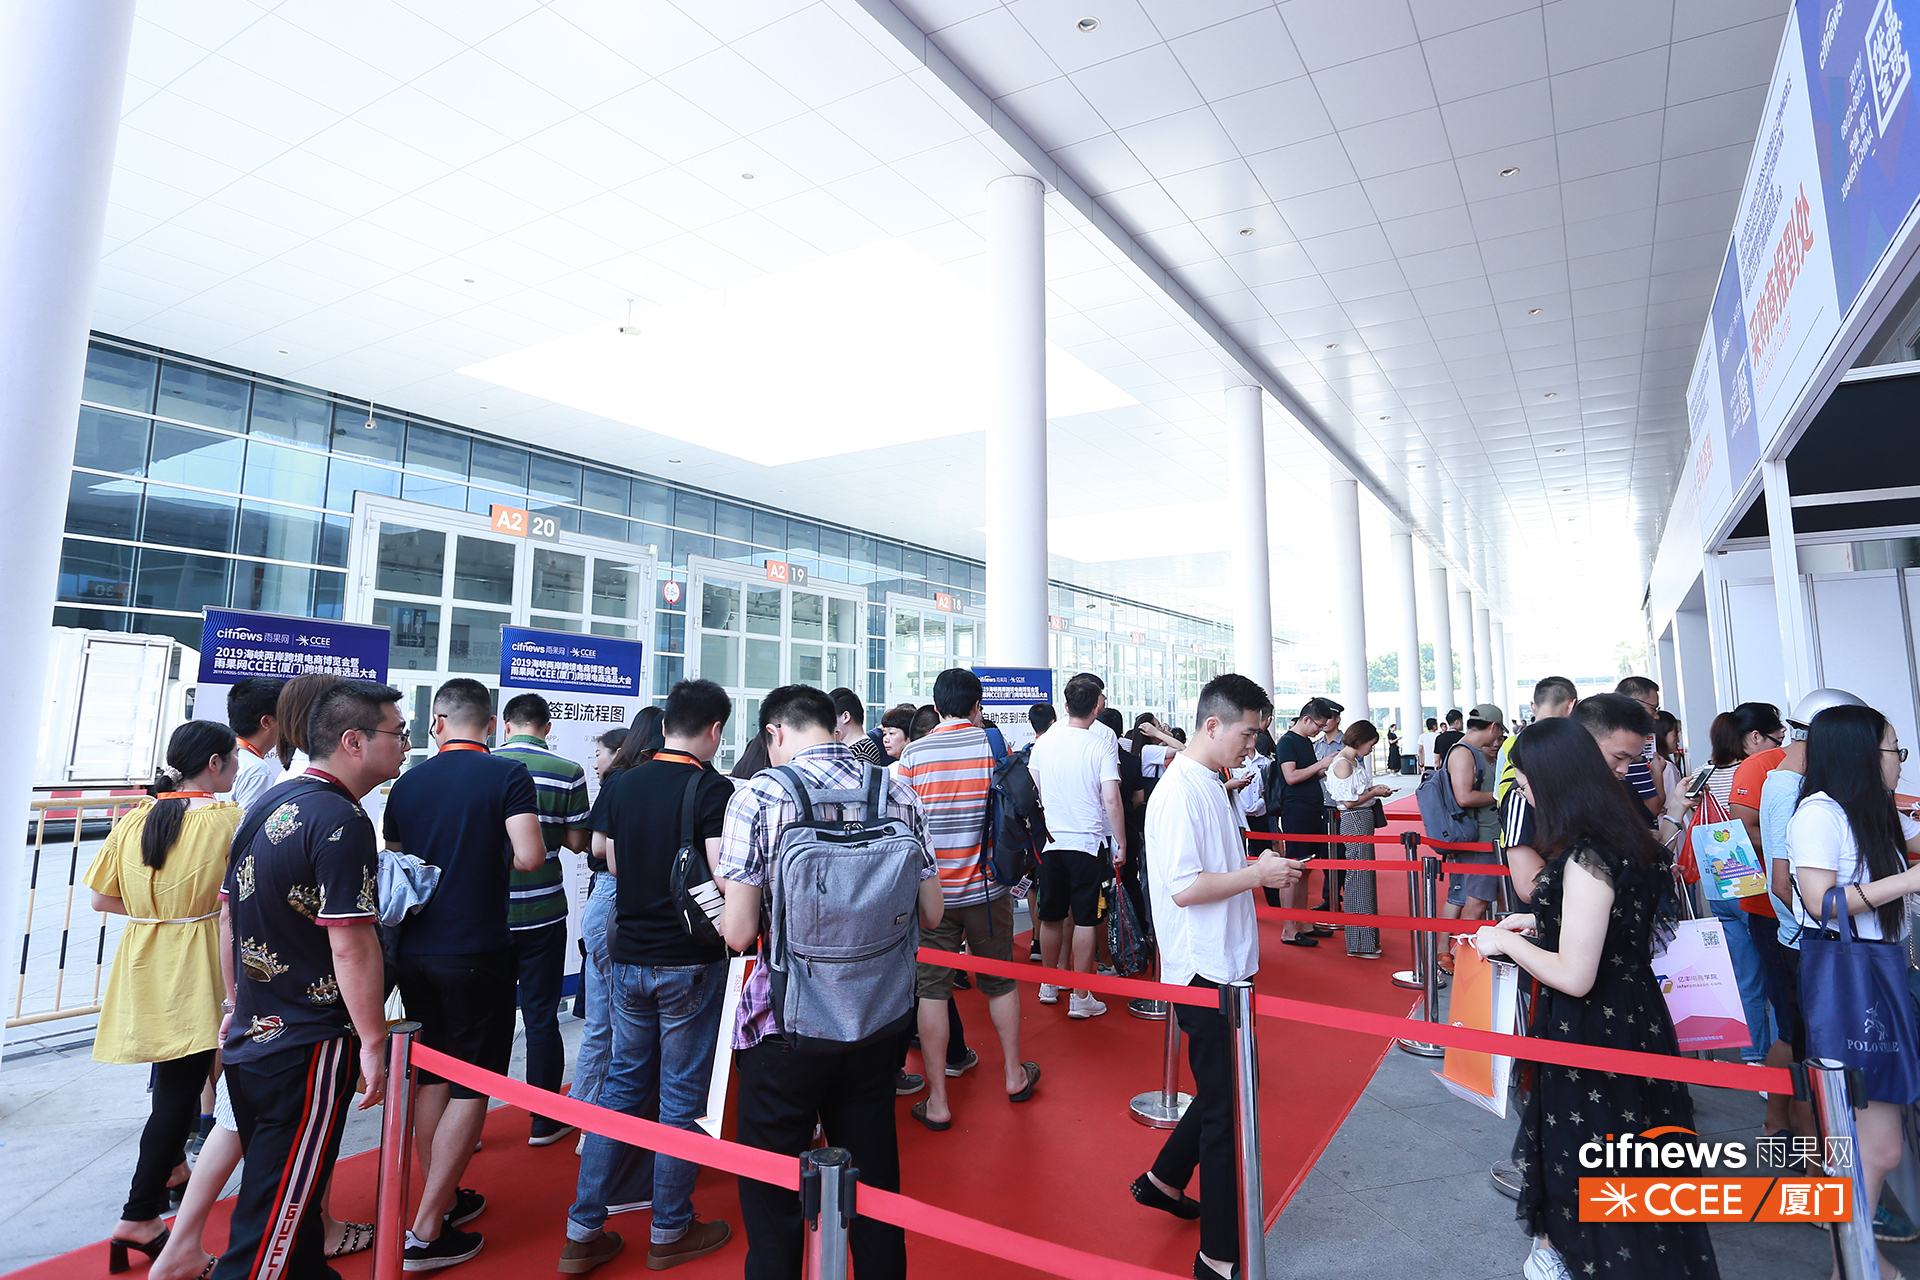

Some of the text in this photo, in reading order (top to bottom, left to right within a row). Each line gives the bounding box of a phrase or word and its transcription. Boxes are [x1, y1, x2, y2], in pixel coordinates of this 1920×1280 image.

[1749, 182, 1814, 370] 采购商报到处
[496, 510, 555, 537] A2 20
[770, 563, 804, 582] A2 19
[938, 596, 961, 611] A2 18
[1051, 618, 1060, 628] A2
[217, 628, 331, 645] cifnews 雨果网 CCEE
[511, 641, 545, 654] cifnews
[580, 648, 596, 657] CCEE
[547, 701, 625, 723] 签到流程图
[983, 712, 1031, 724] 自助签到流
[687, 880, 726, 937] NIK
[266, 1204, 299, 1280] GUCCI
